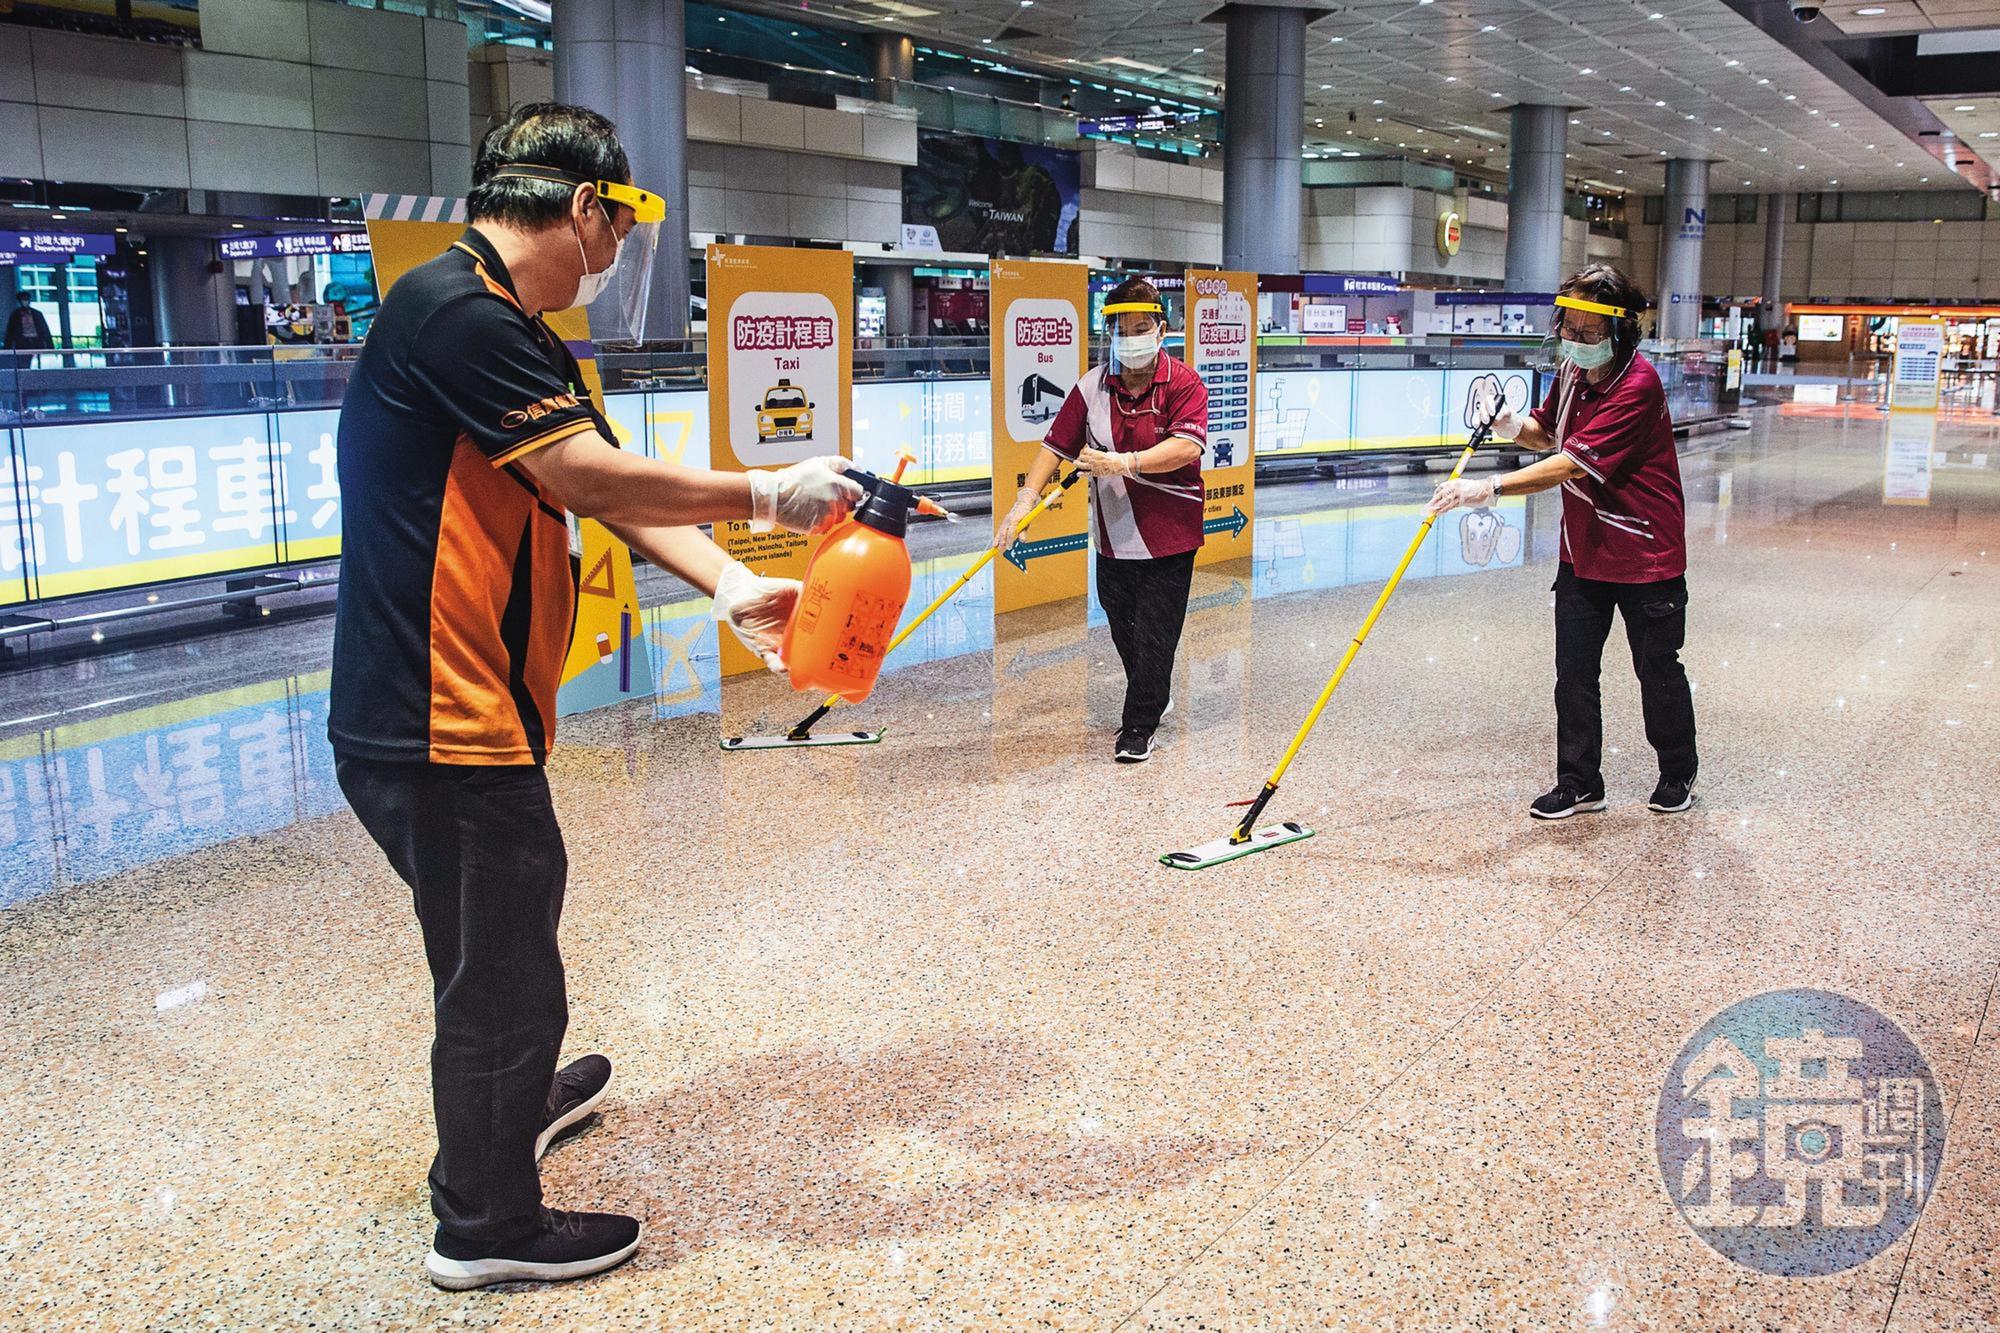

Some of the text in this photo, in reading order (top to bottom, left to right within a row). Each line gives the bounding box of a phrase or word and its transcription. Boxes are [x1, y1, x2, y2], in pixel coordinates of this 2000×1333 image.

[989, 209, 1024, 223] TAIWAN
[735, 316, 833, 349] 防疫計程車
[1016, 317, 1072, 346] 防疫巴士
[1038, 352, 1054, 363] Bus
[1205, 348, 1240, 357] Rental Cars
[774, 357, 800, 370] Taxi
[727, 521, 740, 532] To
[728, 538, 751, 547] (Taipei,
[752, 535, 766, 543] New
[767, 533, 786, 541] Taipei
[728, 539, 808, 556] Taoyuan, Hsinchu, Taitung
[741, 554, 767, 563] offshore
[769, 550, 792, 559] islands)
